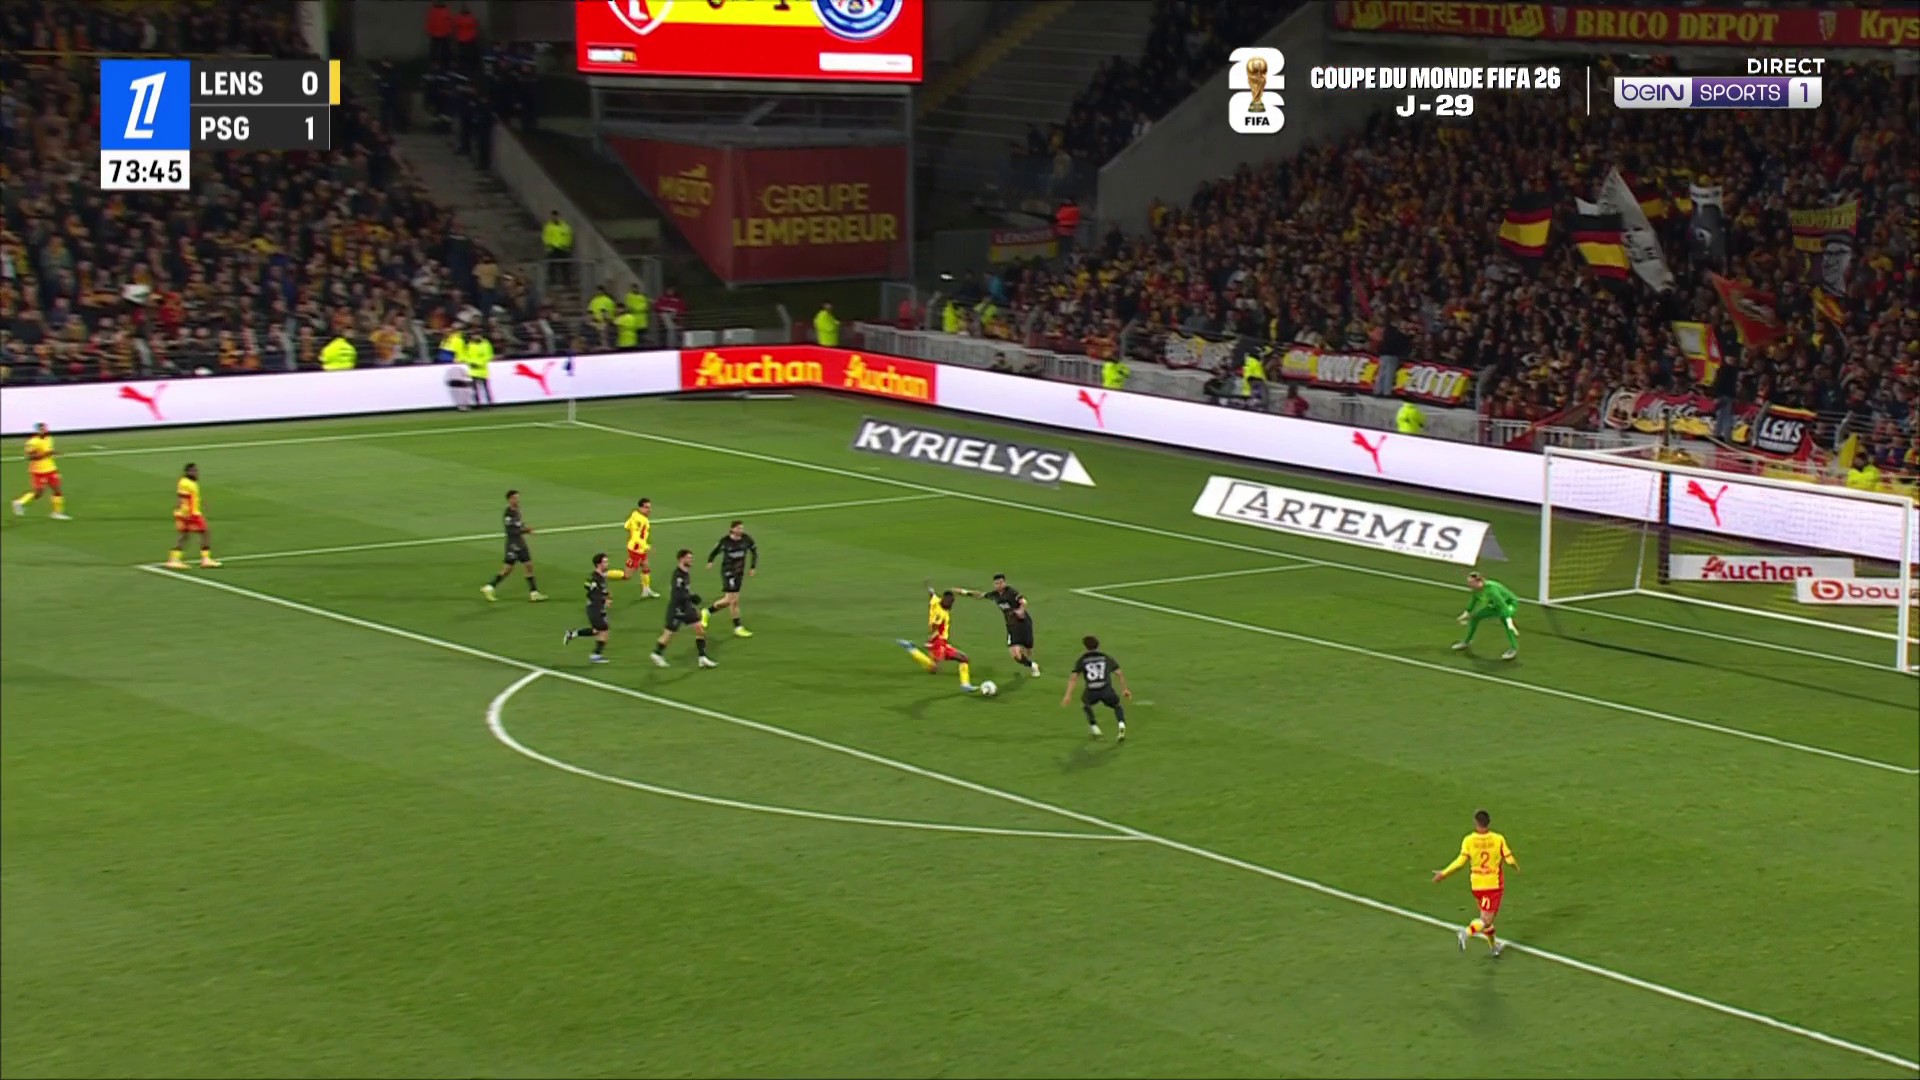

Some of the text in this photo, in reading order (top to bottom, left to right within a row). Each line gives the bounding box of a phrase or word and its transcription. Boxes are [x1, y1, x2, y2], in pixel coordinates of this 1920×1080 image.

[1576, 10, 1667, 38] BRICO
[1679, 12, 1779, 41] DEPOT
[763, 184, 870, 213] GROUPE
[733, 213, 897, 247] LEMPEREUR
[696, 352, 823, 387] Auchan
[844, 354, 929, 400] Auchan
[1760, 416, 1804, 443] LENS
[855, 421, 1063, 482] KYRIELYS
[1237, 490, 1462, 552] ARTEMIS
[1701, 556, 1813, 580] Auchan
[1085, 661, 1106, 681] 87
[1480, 851, 1490, 868] 2
